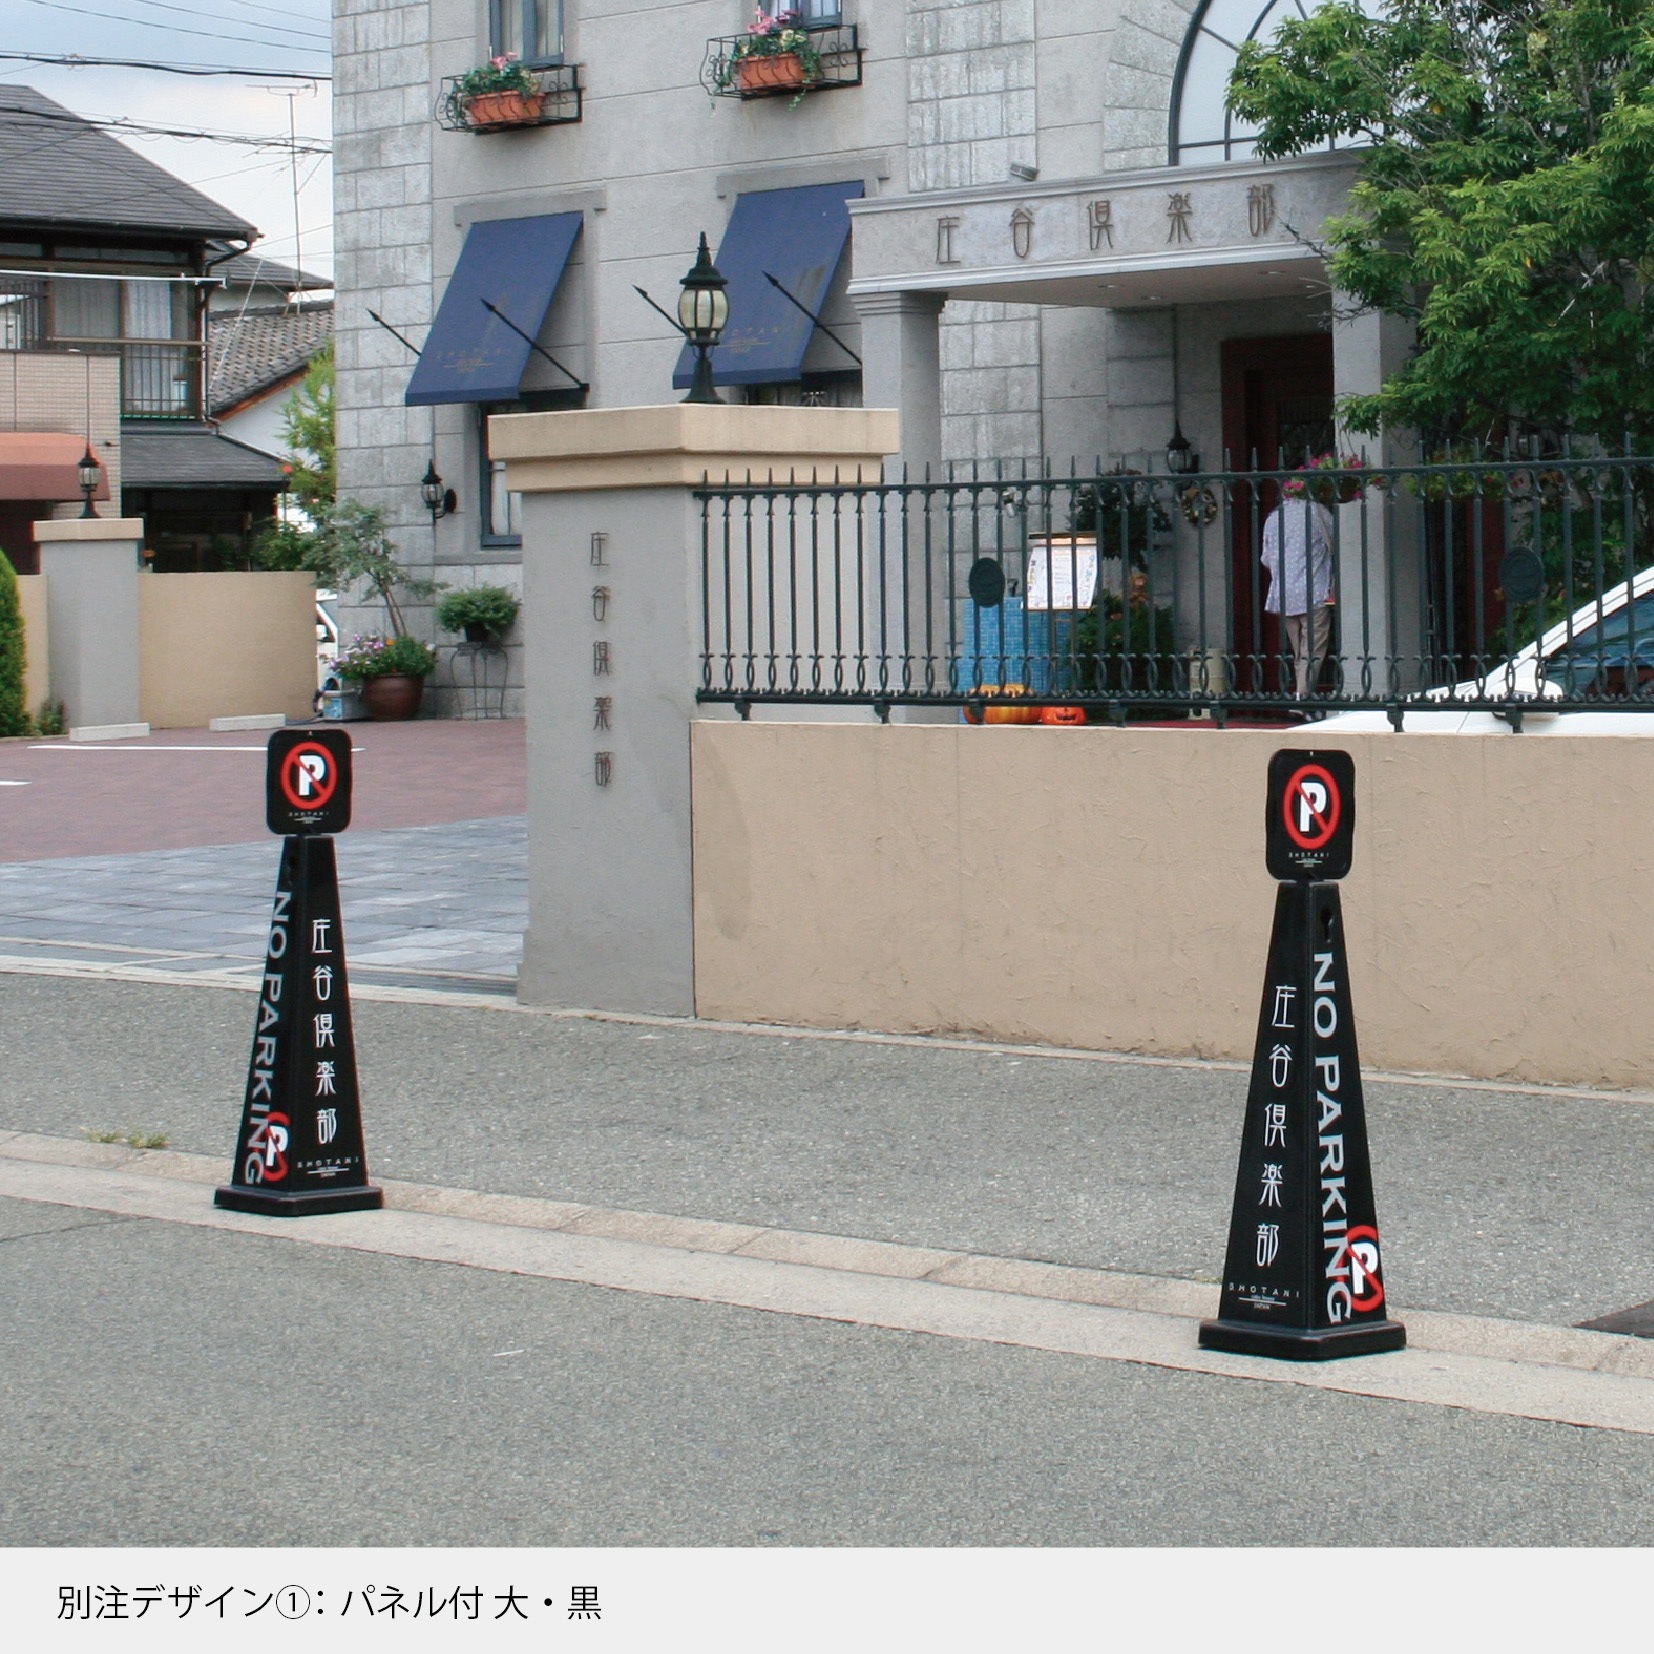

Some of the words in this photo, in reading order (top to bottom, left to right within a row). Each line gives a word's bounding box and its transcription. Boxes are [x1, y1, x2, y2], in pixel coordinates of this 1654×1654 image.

[298, 755, 325, 796] P
[1300, 782, 1327, 832] P
[269, 891, 292, 959] NO
[1313, 952, 1337, 1039] NO
[245, 973, 281, 1184] PARKING
[266, 1127, 289, 1167] P
[1315, 1055, 1352, 1324] PARKING
[1229, 1282, 1300, 1298] SHOTANI
[1350, 1242, 1379, 1294] P
